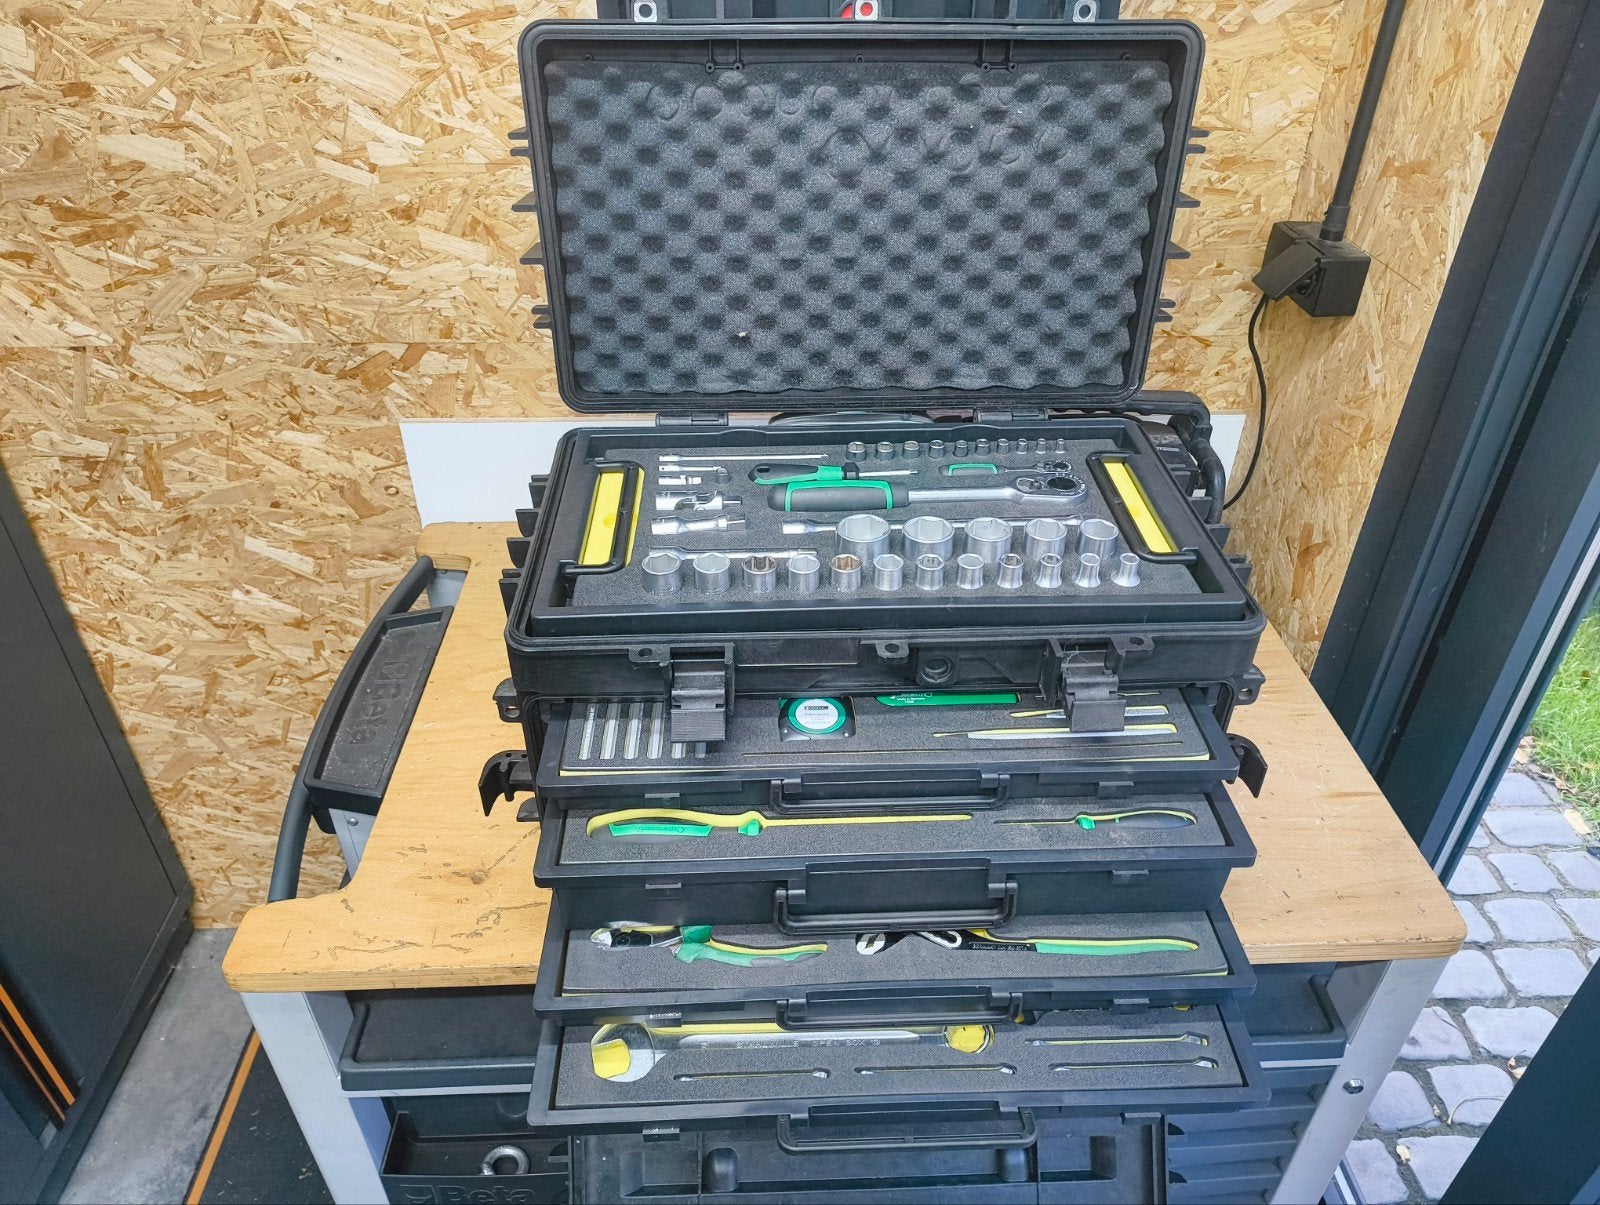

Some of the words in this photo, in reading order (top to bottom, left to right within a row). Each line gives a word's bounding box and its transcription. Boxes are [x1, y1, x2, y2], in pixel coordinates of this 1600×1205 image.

[349, 683, 402, 745] Beta
[812, 1039, 840, 1047] OPEN
[845, 1039, 866, 1047] BOX
[437, 1185, 536, 1205] Beta
